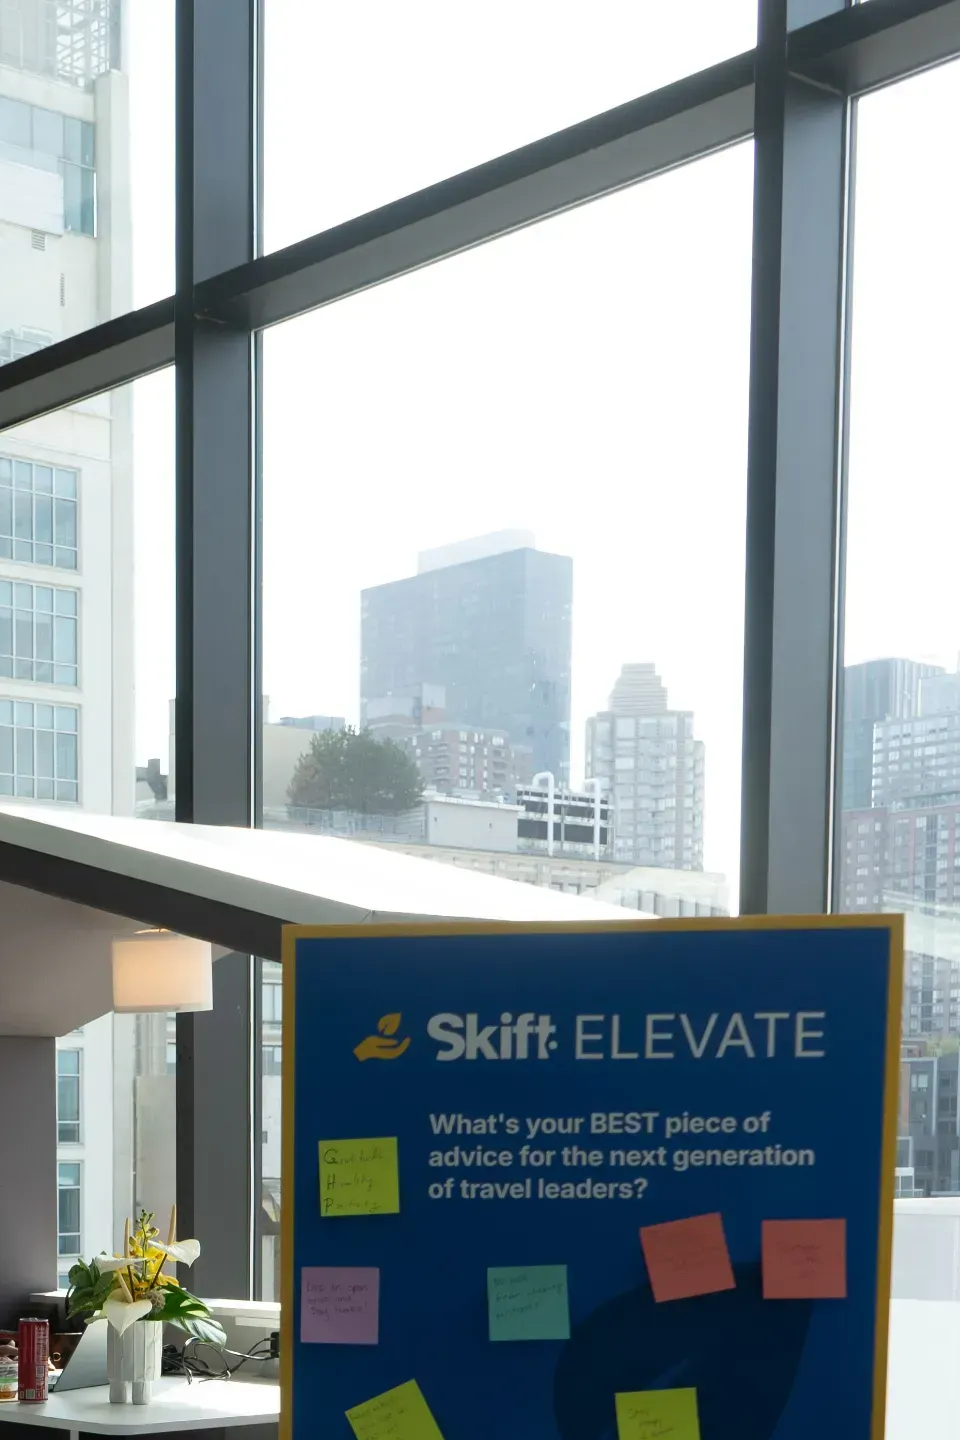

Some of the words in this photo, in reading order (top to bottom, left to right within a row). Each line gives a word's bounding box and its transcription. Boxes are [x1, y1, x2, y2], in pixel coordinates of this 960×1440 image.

[574, 1011, 826, 1060] ELEVATE
[429, 1112, 519, 1135] What's
[525, 1117, 585, 1139] your
[590, 1111, 659, 1134] BEST
[665, 1111, 738, 1139] piece
[742, 1111, 771, 1133] of
[428, 1145, 513, 1167] advice
[519, 1145, 556, 1167] for
[561, 1145, 603, 1167] the
[609, 1147, 667, 1167] next
[673, 1144, 815, 1172] generation
[428, 1178, 455, 1199] of
[460, 1178, 531, 1199] travel
[539, 1177, 648, 1199] leaders?
